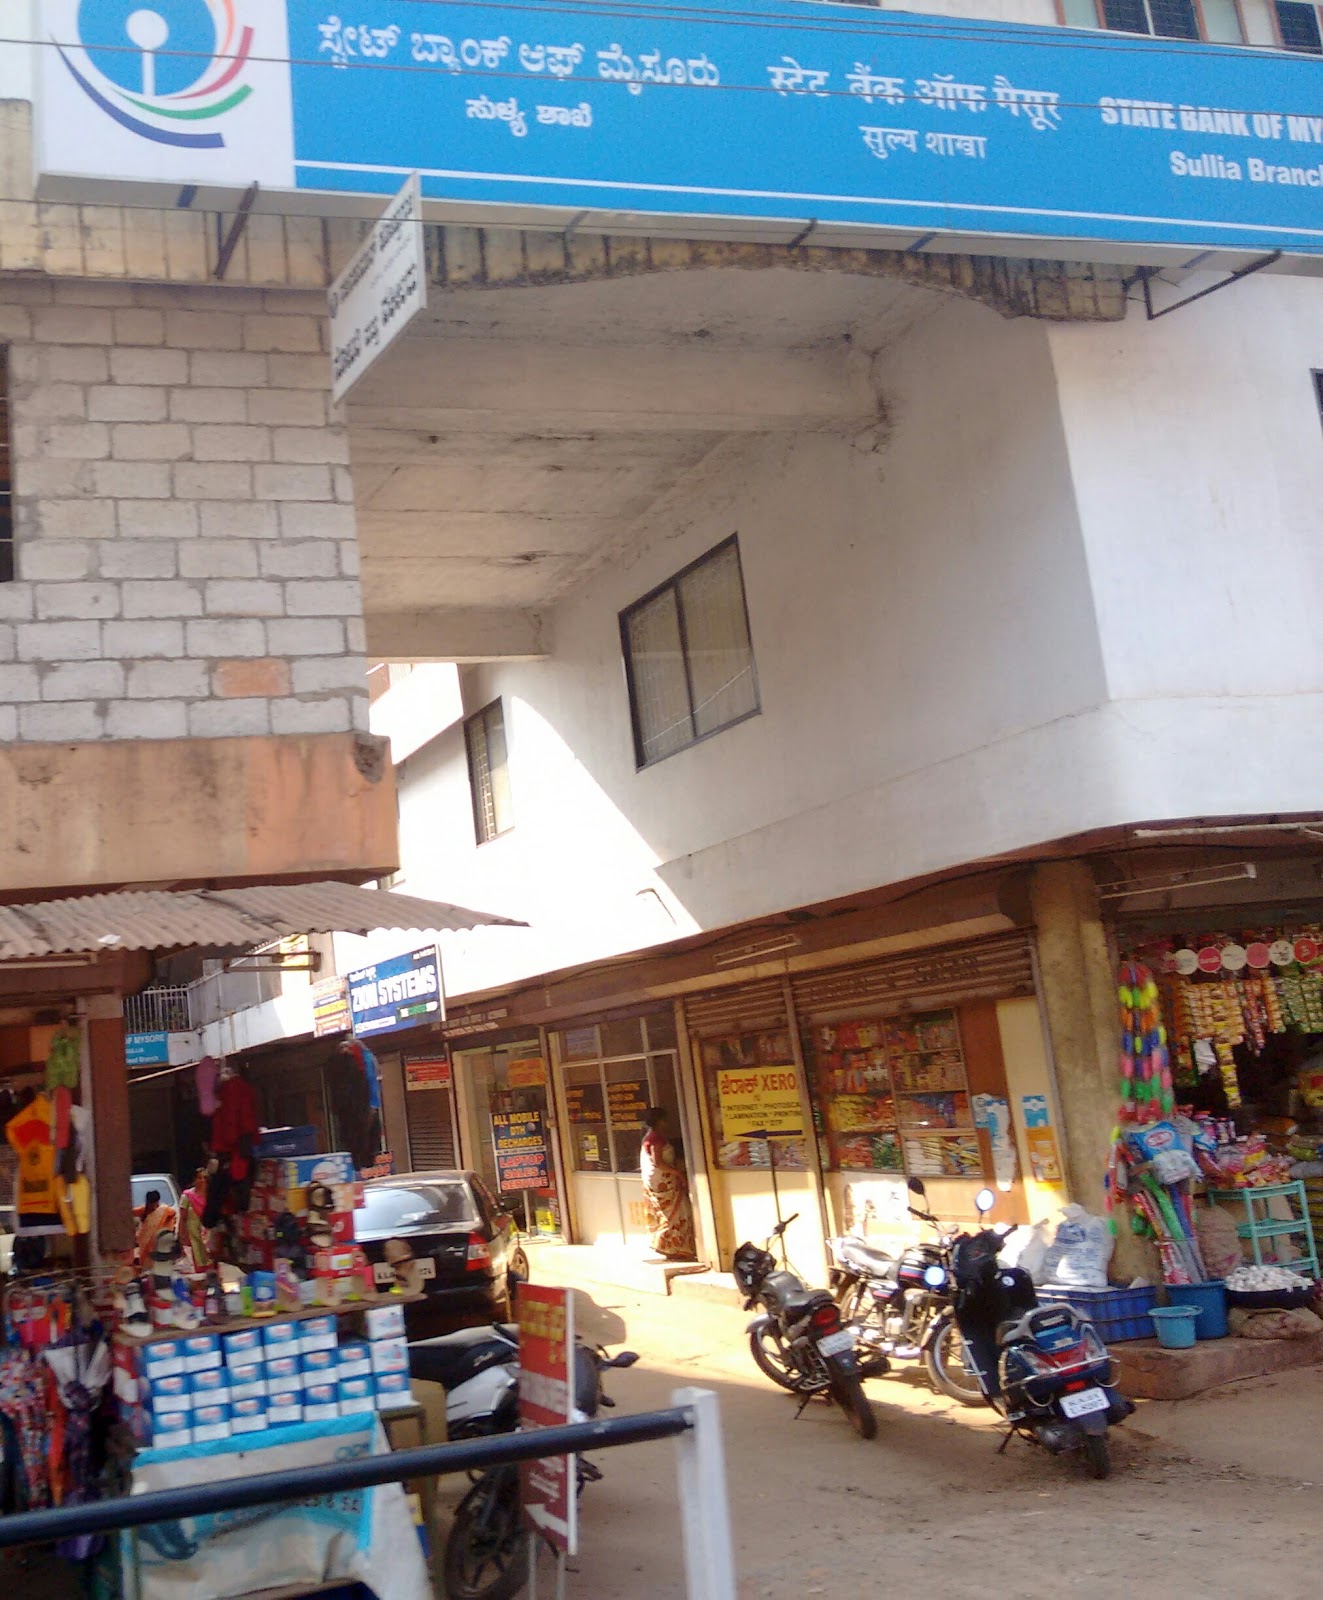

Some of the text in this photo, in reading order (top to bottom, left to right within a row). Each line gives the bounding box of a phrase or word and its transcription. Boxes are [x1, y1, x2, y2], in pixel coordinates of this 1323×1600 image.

[318, 15, 720, 95] ಸ್ಟೇಟ್ ಬ್ಯಾಂಕ್ ಆಫ್ ಮೈಸೂರು
[766, 55, 830, 97] स्टेट
[844, 61, 906, 105] बैंक
[992, 74, 1063, 131] मैसूर
[536, 101, 593, 128] ಶಾಖೆ
[1099, 97, 1178, 130] STATE
[1178, 104, 1251, 137] BANK
[1251, 112, 1284, 140] OF
[925, 131, 988, 159] शाखा
[1169, 150, 1242, 181] Sullia
[377, 965, 437, 1006] SYSTEMS
[761, 1073, 799, 1091] XERO
[493, 1112, 540, 1126] ALL MOBILE
[510, 1126, 525, 1135] DTH
[499, 1153, 544, 1168] LAPTOP
[503, 1167, 539, 1179] SALES
[501, 1176, 549, 1191] SERVICE
